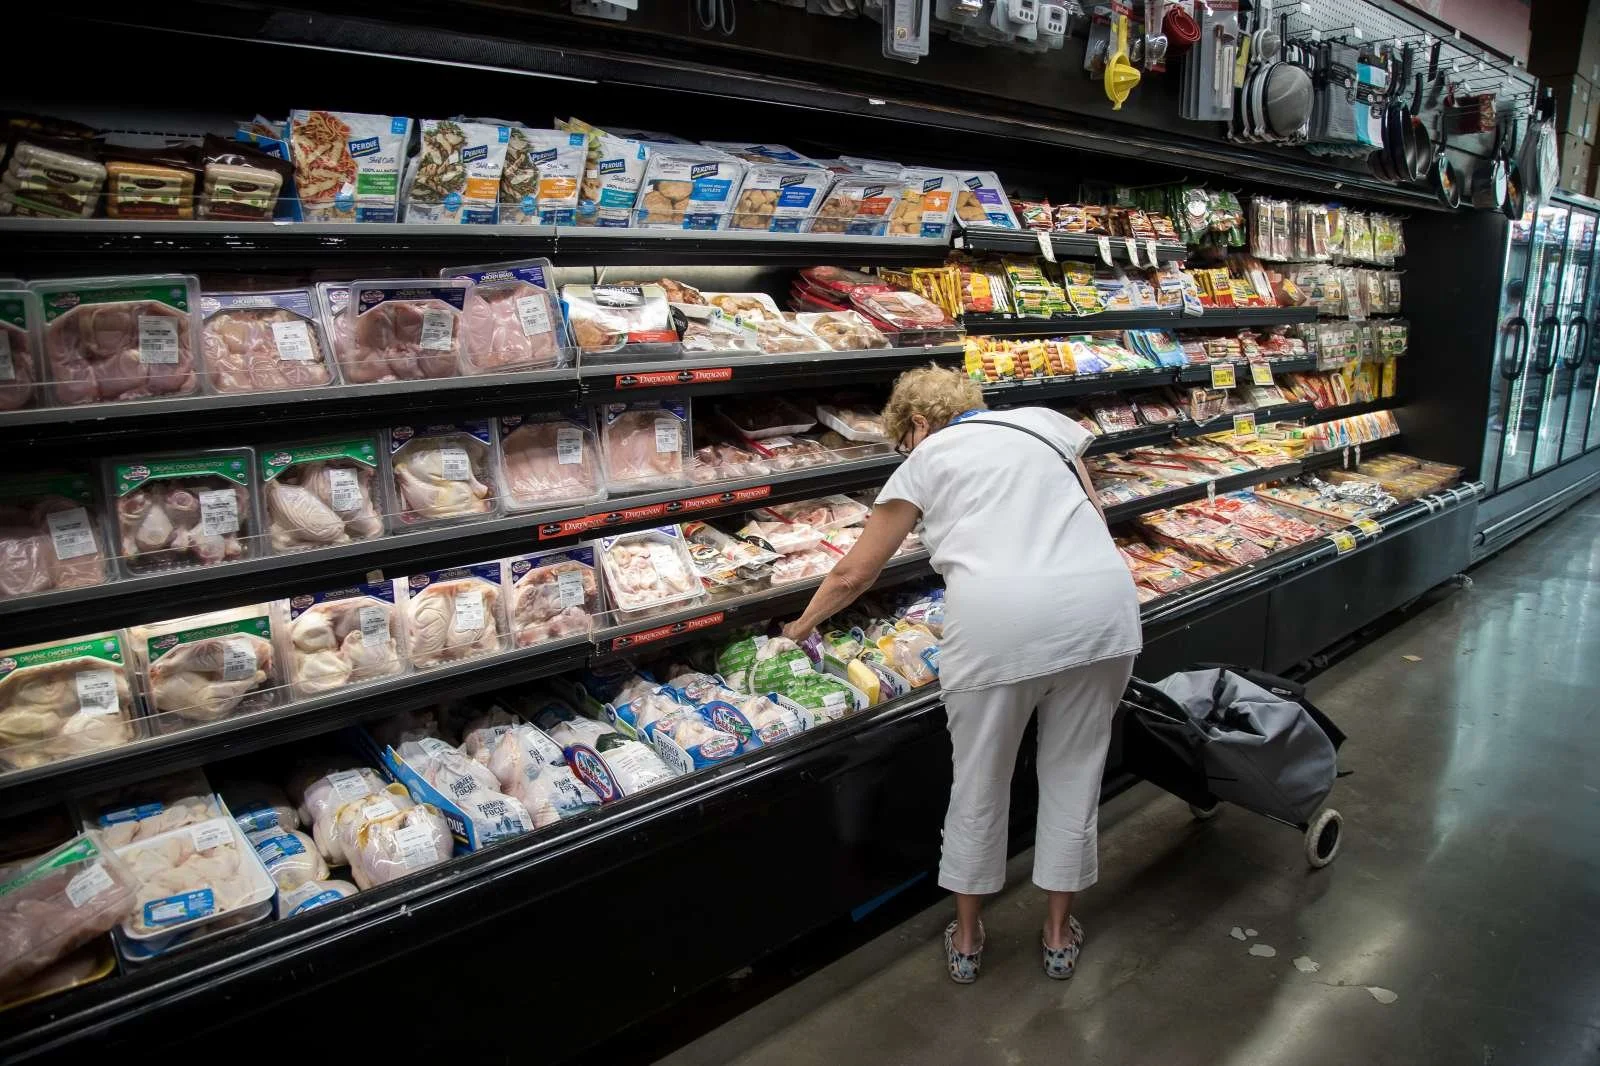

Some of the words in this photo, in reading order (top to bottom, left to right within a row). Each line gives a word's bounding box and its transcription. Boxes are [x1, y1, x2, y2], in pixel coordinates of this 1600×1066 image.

[351, 139, 378, 151] PERDUE
[464, 147, 487, 158] PERDUE
[601, 161, 624, 170] PERDUE
[692, 165, 717, 174] PERDUE
[449, 774, 474, 792] FARMER
[455, 781, 478, 799] FOCUS
[476, 800, 505, 812] FARMER
[447, 818, 466, 835] DUE
